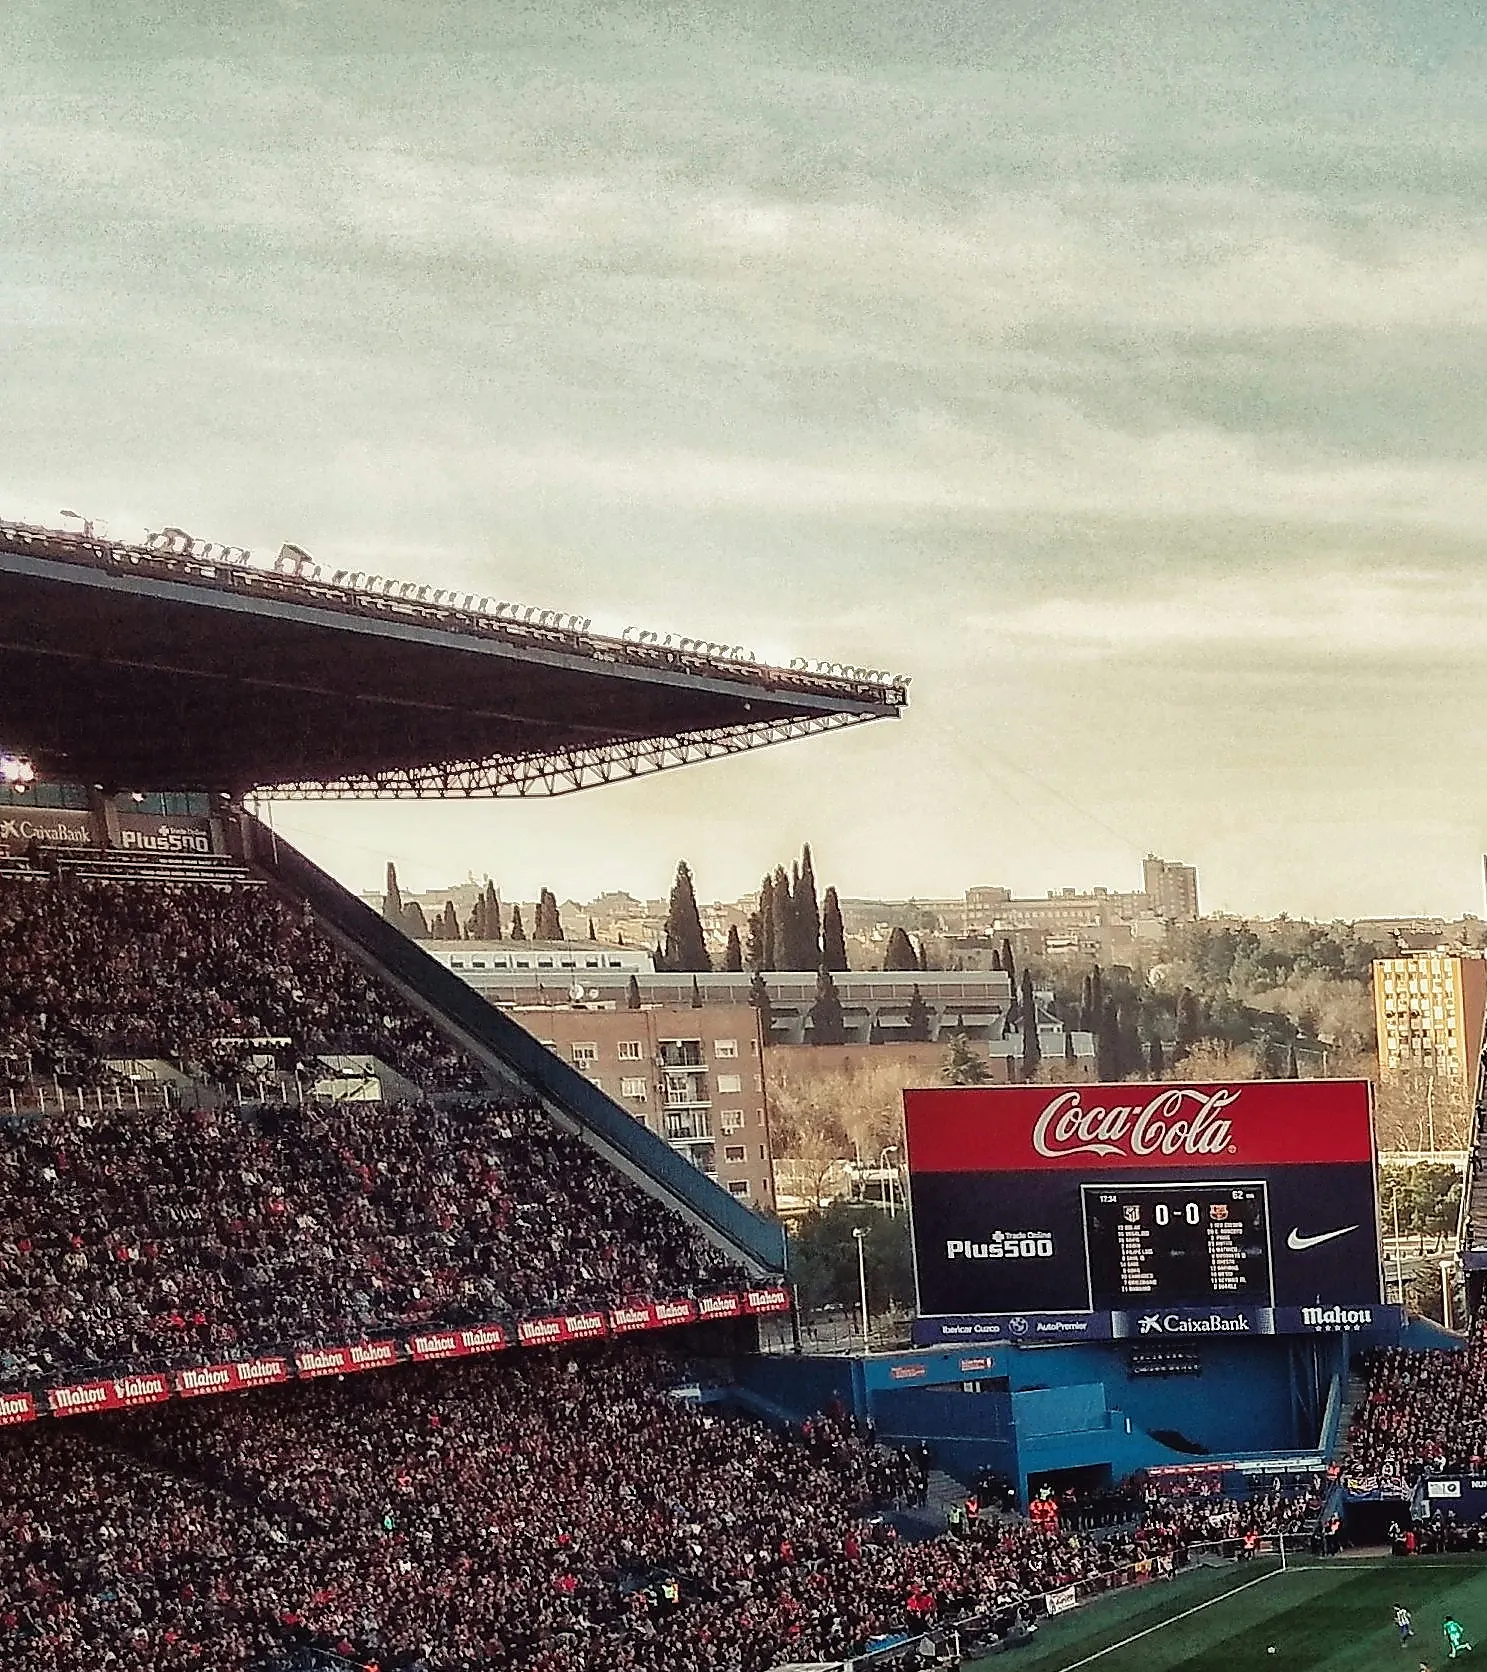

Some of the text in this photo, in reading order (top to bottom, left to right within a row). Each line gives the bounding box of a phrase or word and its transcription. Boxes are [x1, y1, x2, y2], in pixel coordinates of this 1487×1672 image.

[20, 821, 91, 842] CaixaBank
[122, 830, 208, 851] Plus500
[1033, 1088, 1242, 1157] Coca-Cola
[1155, 1204, 1169, 1225] 0
[1185, 1203, 1199, 1224] 0
[947, 1239, 1054, 1260] Plus500
[704, 1296, 736, 1314] Mahou
[749, 1290, 785, 1307] Mahou
[616, 1308, 649, 1326] Mahou
[656, 1303, 690, 1319] Mahou
[1301, 1306, 1372, 1326] Mahou
[523, 1319, 560, 1339] Mahou
[565, 1314, 601, 1331] Mahou
[1036, 1321, 1087, 1333] AutoPremier
[1164, 1315, 1249, 1335] CaixaBank
[415, 1335, 456, 1352] Mahou
[462, 1329, 500, 1347] Mahou
[302, 1350, 344, 1370] Mahou
[352, 1344, 391, 1363] Mahou
[182, 1368, 229, 1389] Mahou
[238, 1360, 281, 1380] Mahou
[55, 1386, 107, 1408] Mahou
